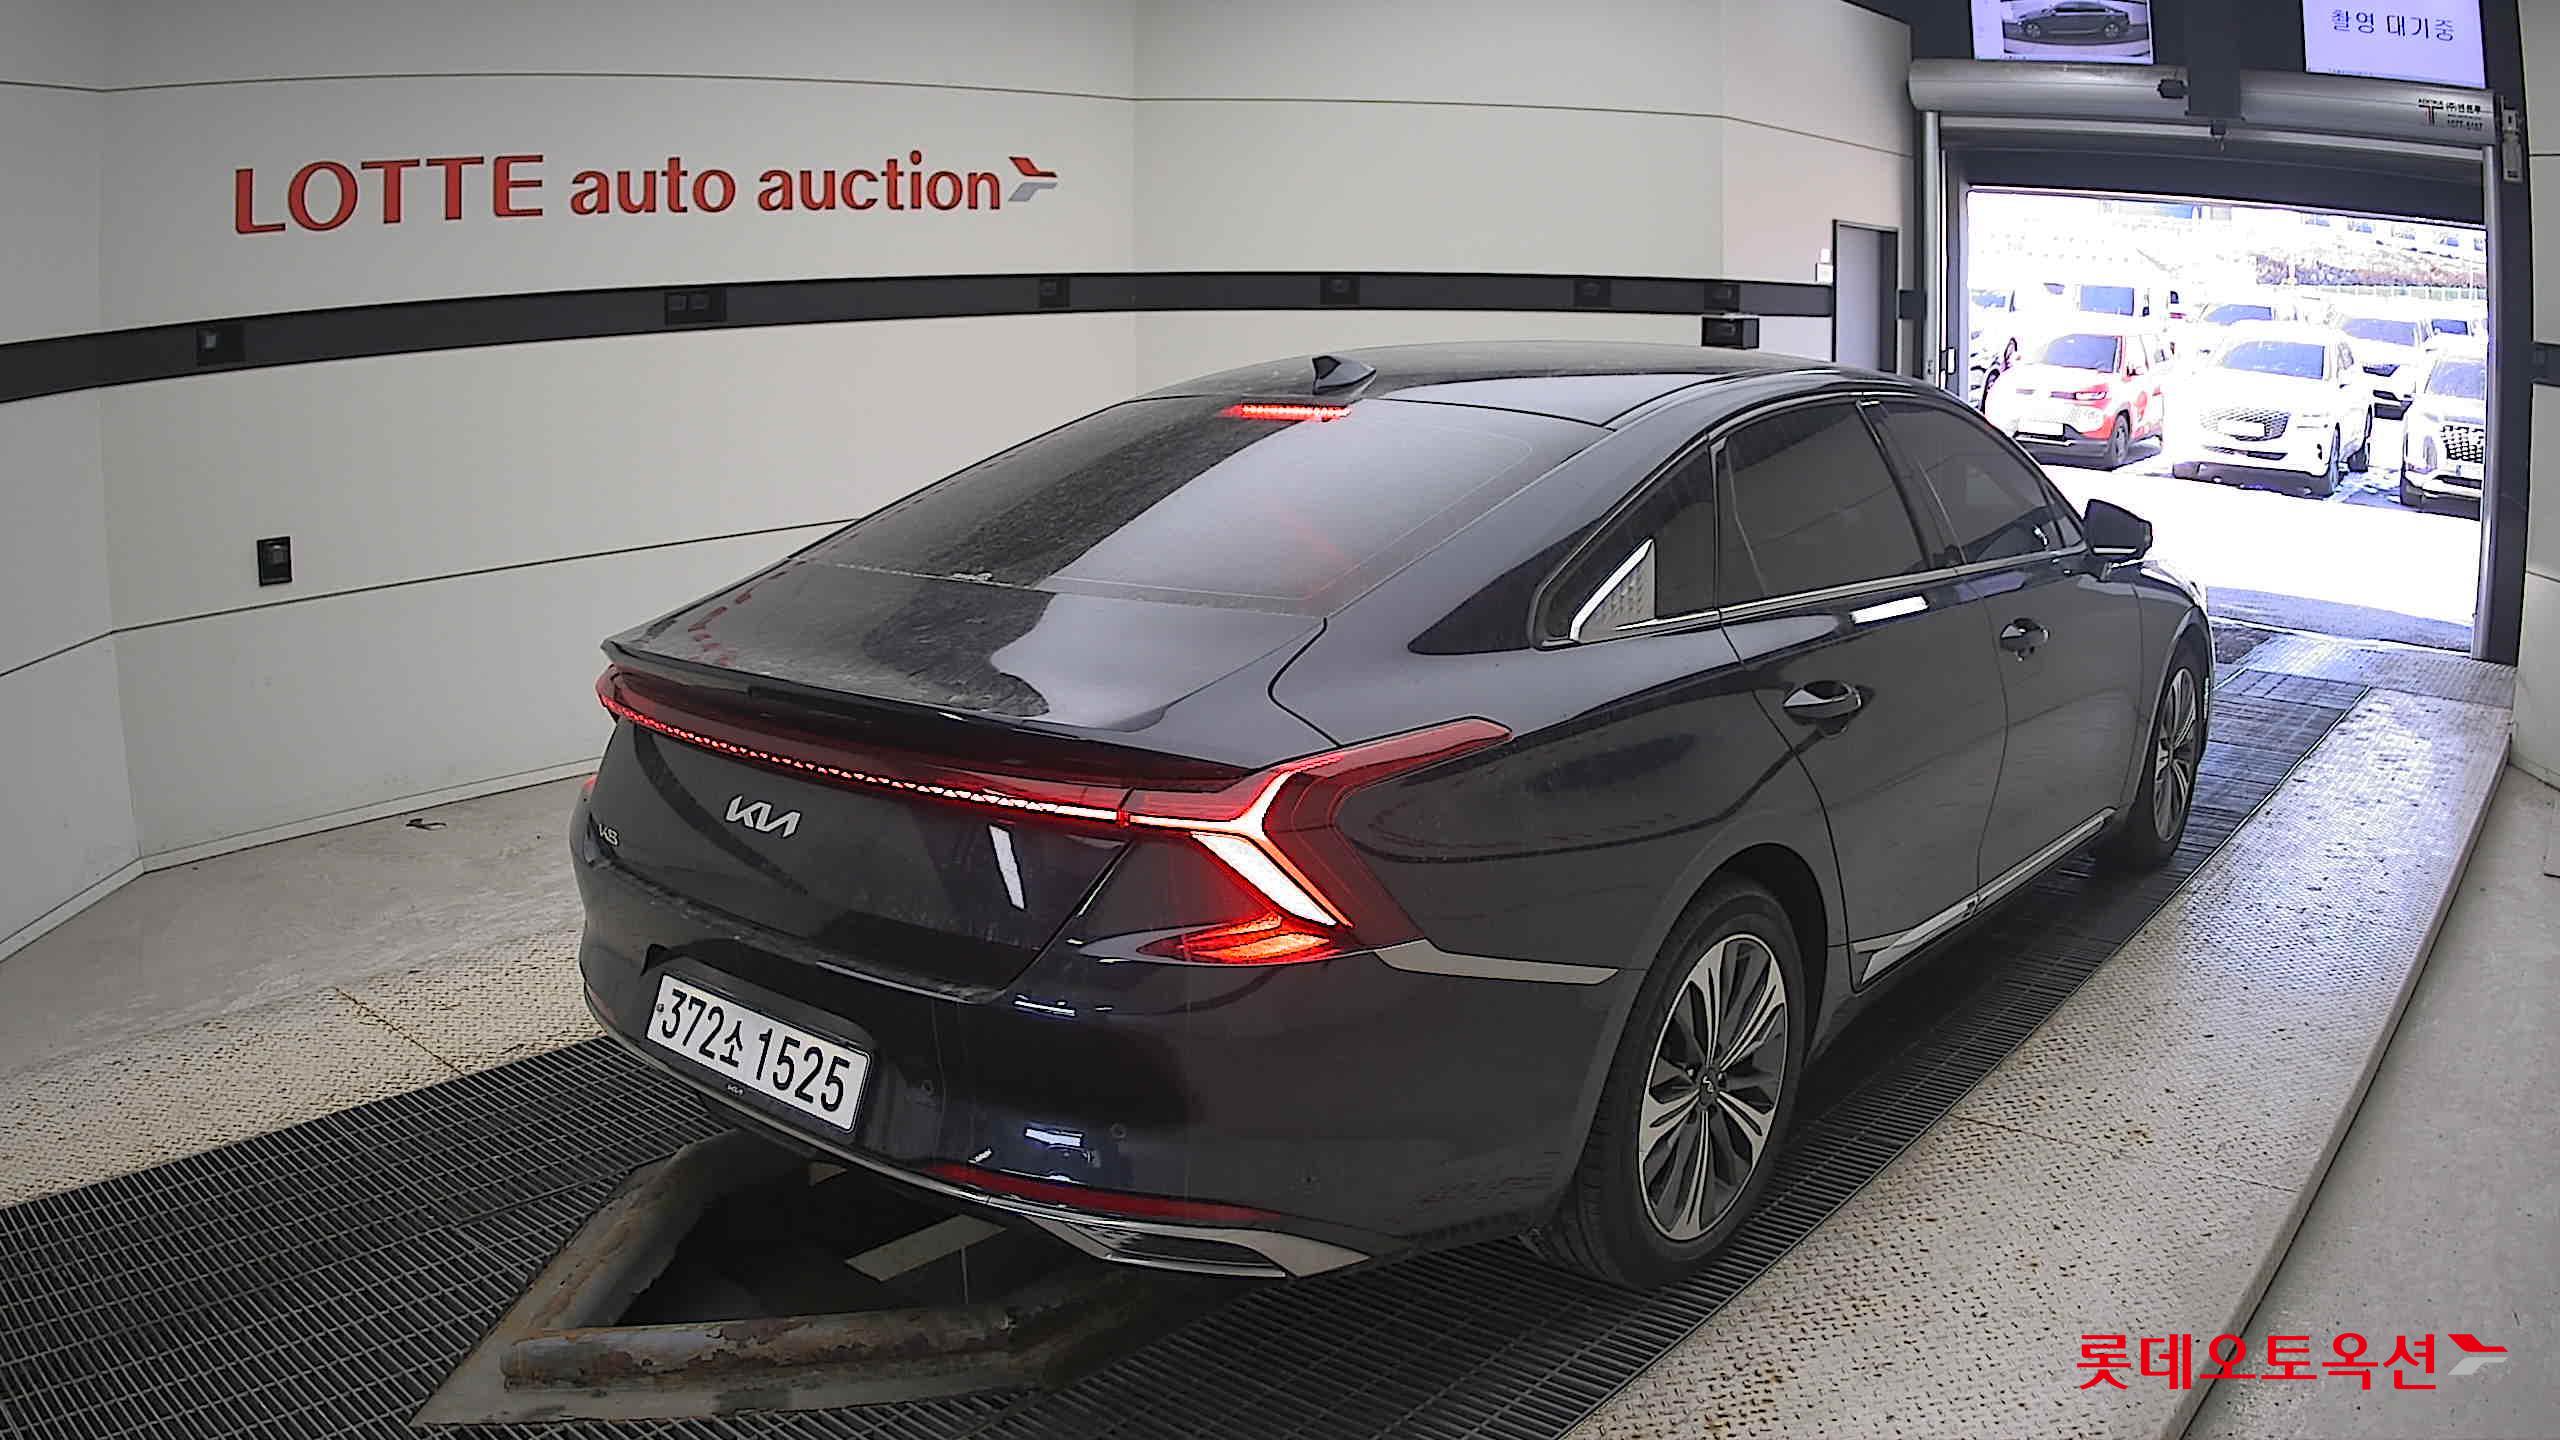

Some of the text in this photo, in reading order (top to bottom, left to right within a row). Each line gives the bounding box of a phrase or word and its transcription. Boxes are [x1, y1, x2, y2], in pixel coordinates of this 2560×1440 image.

[2386, 15, 2454, 42] 대기중
[235, 150, 1001, 234] LOTTE auto auction
[727, 795, 801, 838] KIA
[755, 1027, 850, 1113] 1525
